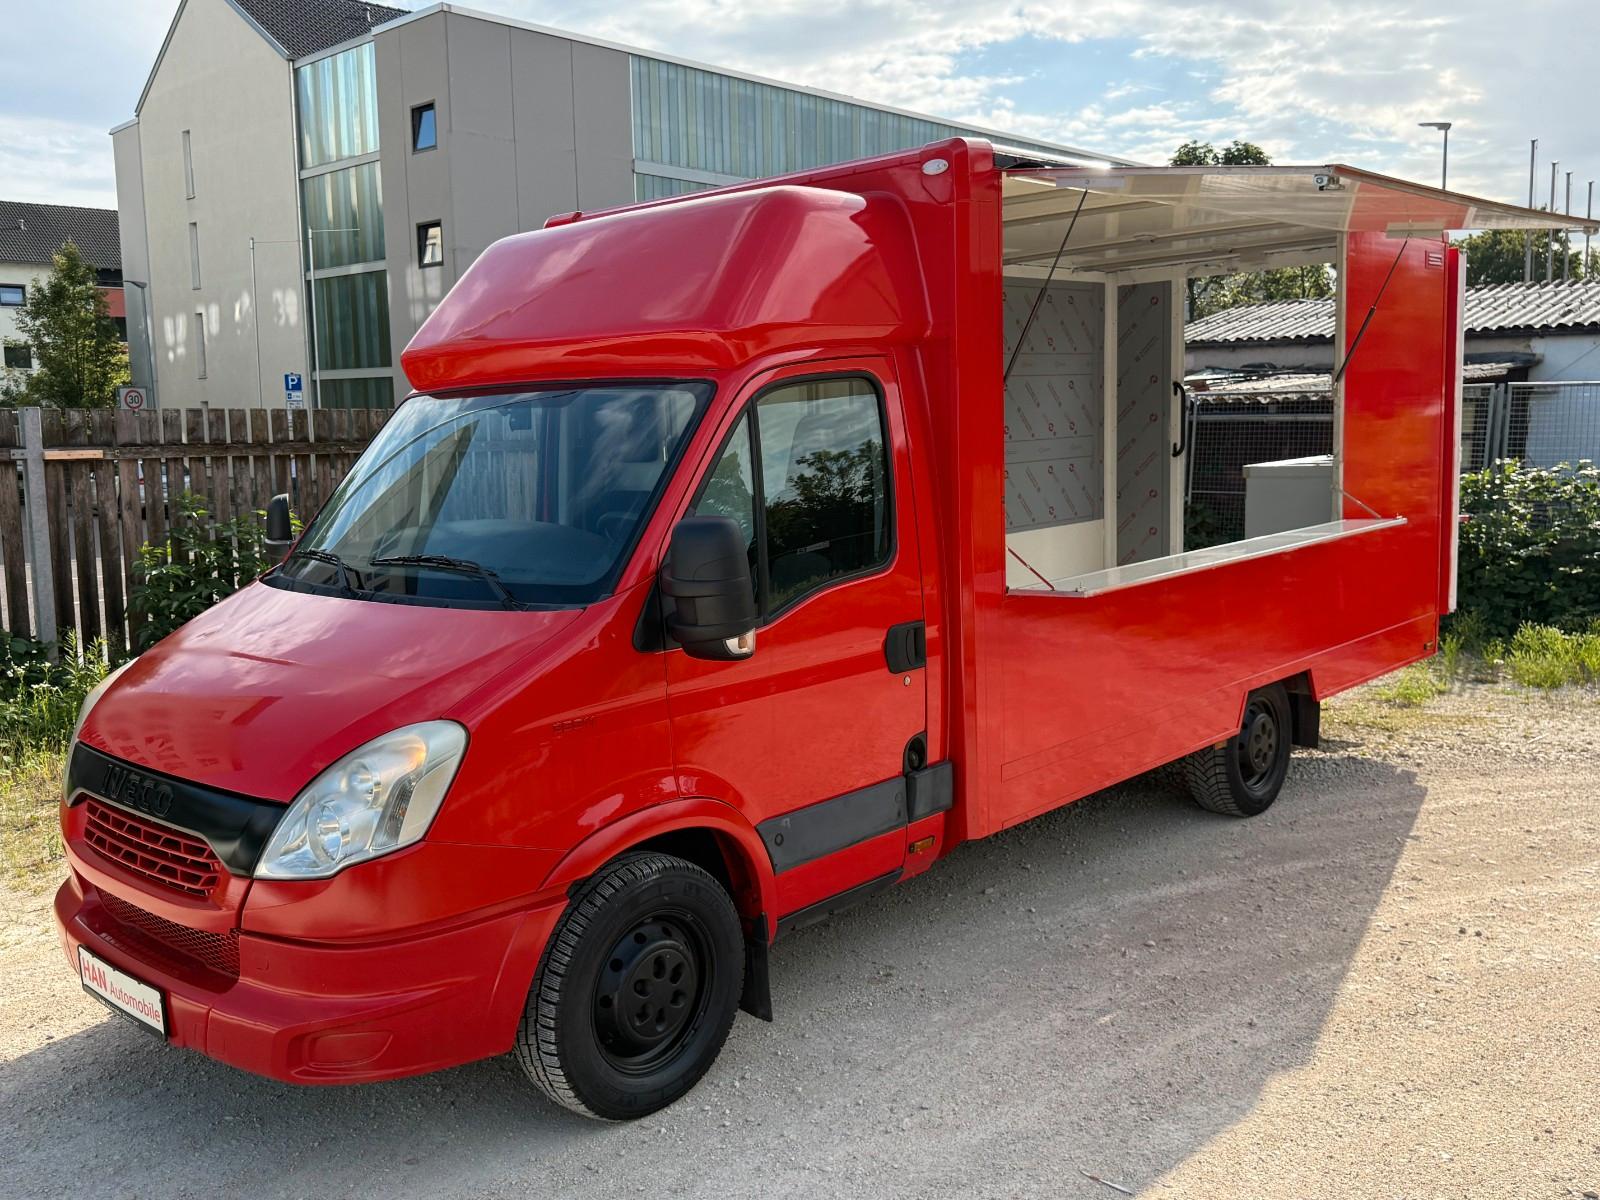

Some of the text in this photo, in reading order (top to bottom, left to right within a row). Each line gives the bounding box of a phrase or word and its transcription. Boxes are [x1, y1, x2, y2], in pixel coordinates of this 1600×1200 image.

[288, 376, 298, 389] P
[128, 395, 140, 404] 30
[101, 763, 174, 817] IVECO
[81, 956, 108, 993] HAN
[110, 981, 162, 1022] Automobile
